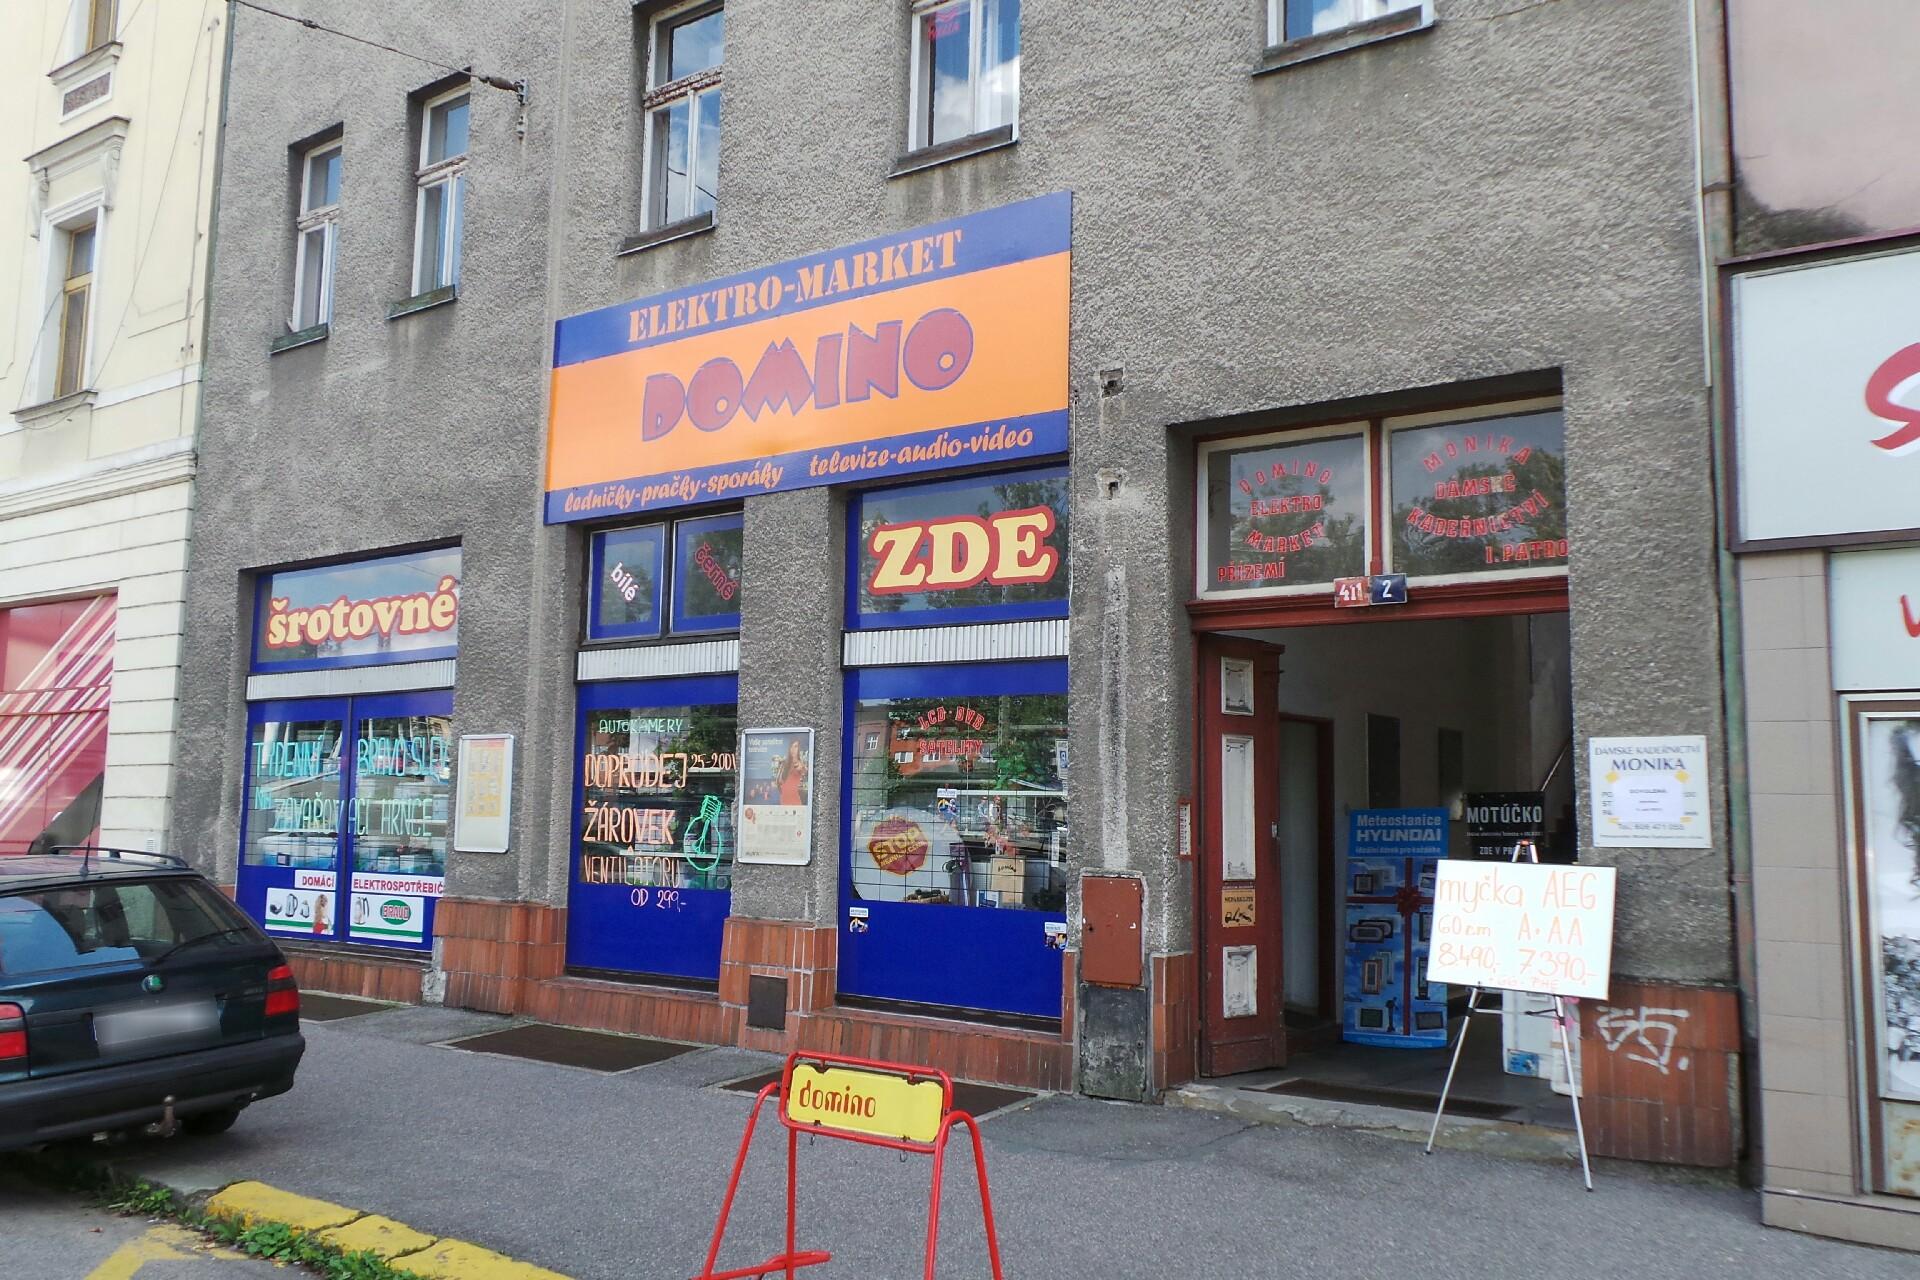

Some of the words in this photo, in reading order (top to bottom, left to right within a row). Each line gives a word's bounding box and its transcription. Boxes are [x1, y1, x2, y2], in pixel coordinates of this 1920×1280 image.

[628, 230, 962, 343] ELEKTRO-MARKET
[642, 308, 974, 442] DOMINO
[1423, 433, 1533, 472] MONIKA
[564, 462, 784, 514] ledničky-pračky-sporáky
[809, 425, 1033, 477] televize-audio-video
[1238, 458, 1333, 495] DOMINO
[1435, 470, 1516, 500] DÁMSKÉ
[1250, 494, 1323, 516] ELEKTRO
[869, 506, 1057, 594] ZDE
[1244, 521, 1326, 553] MARKET
[1502, 539, 1568, 561] PATRO
[610, 562, 641, 602] bílé
[1217, 557, 1285, 582] PŘÍZEMÍ
[1339, 582, 1363, 601] 411
[1382, 580, 1392, 598] 2
[266, 575, 458, 648] šrotovné
[598, 718, 683, 734] AUTOKAMERY
[917, 707, 946, 731] LCD
[956, 706, 986, 730] DVB
[919, 739, 983, 755] SATELITY
[584, 753, 687, 788] DOPRODEJ
[1611, 758, 1686, 771] MONIKA
[583, 799, 675, 845] ŽÁROVEK
[1357, 814, 1441, 827] Meteostanice
[1467, 803, 1542, 823] MOTÚČKO
[1356, 829, 1441, 842] HYUNDAI
[302, 874, 334, 888] DOMÁCÍ
[1439, 866, 1524, 913] myčka
[1543, 870, 1597, 910] AEG
[631, 888, 648, 907] OD
[799, 1079, 876, 1118] domino
